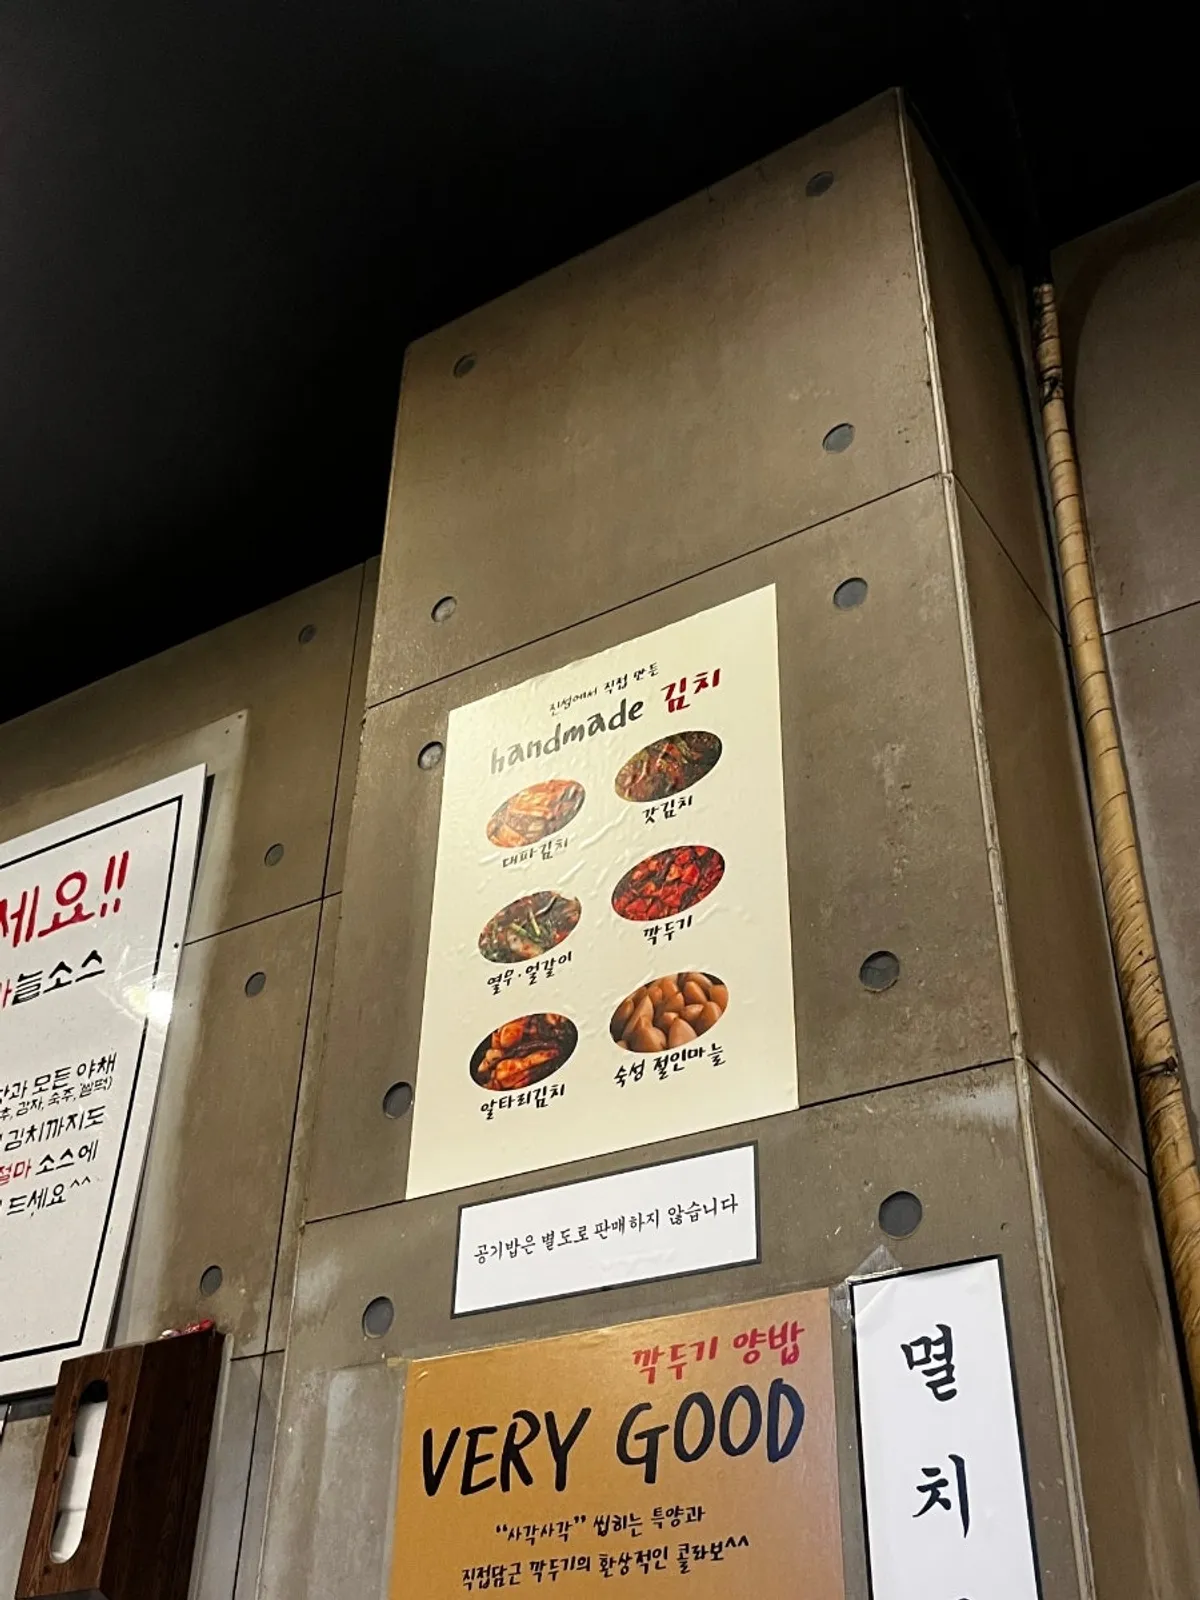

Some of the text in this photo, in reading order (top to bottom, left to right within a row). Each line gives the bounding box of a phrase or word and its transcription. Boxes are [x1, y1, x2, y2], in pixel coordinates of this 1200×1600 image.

[603, 673, 628, 695] 직접
[633, 661, 659, 681] 만든
[489, 667, 722, 776] handmade 김치
[641, 795, 693, 825] 갓김치
[502, 837, 569, 868] 대파김치
[643, 914, 693, 946] 깍두기
[31, 1066, 72, 1096] 모든
[76, 1051, 117, 1079] 야채
[613, 1043, 727, 1088] 숙성 절인마늘
[15, 1096, 45, 1117] 감자,
[47, 1086, 76, 1106] 숙주,
[480, 1083, 566, 1121] 알타리김치
[4, 1105, 106, 1152] 김치까지도
[35, 1139, 99, 1175] 소스에
[473, 1193, 739, 1265] 공기밥은 별도로 판매하지 않습니다
[632, 1320, 806, 1385] 깍두기 양밥
[422, 1377, 806, 1497] VERY GOOD
[900, 1323, 971, 1600] 멸치
[593, 1512, 644, 1538] 씹히는
[650, 1505, 706, 1530] 특양과
[461, 1561, 523, 1592] 직접담근
[529, 1555, 592, 1583] 깍두기의
[598, 1546, 669, 1579] 환상적인
